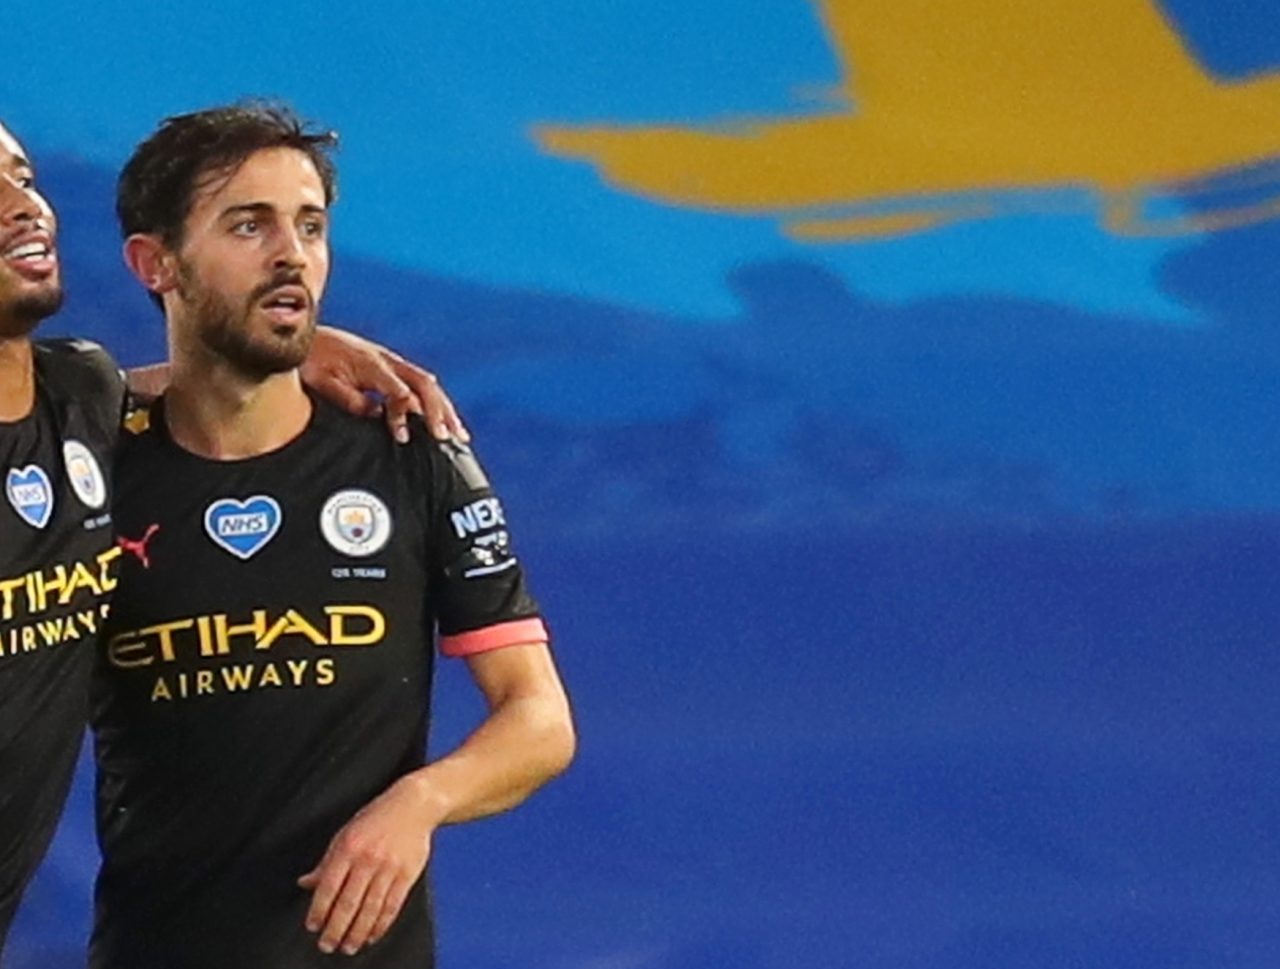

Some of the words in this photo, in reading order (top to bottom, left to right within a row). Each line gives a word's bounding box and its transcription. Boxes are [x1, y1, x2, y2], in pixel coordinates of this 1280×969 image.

[222, 515, 263, 533] NHS
[109, 605, 386, 667] ETIHAD
[151, 659, 335, 702] AIRWAYS
